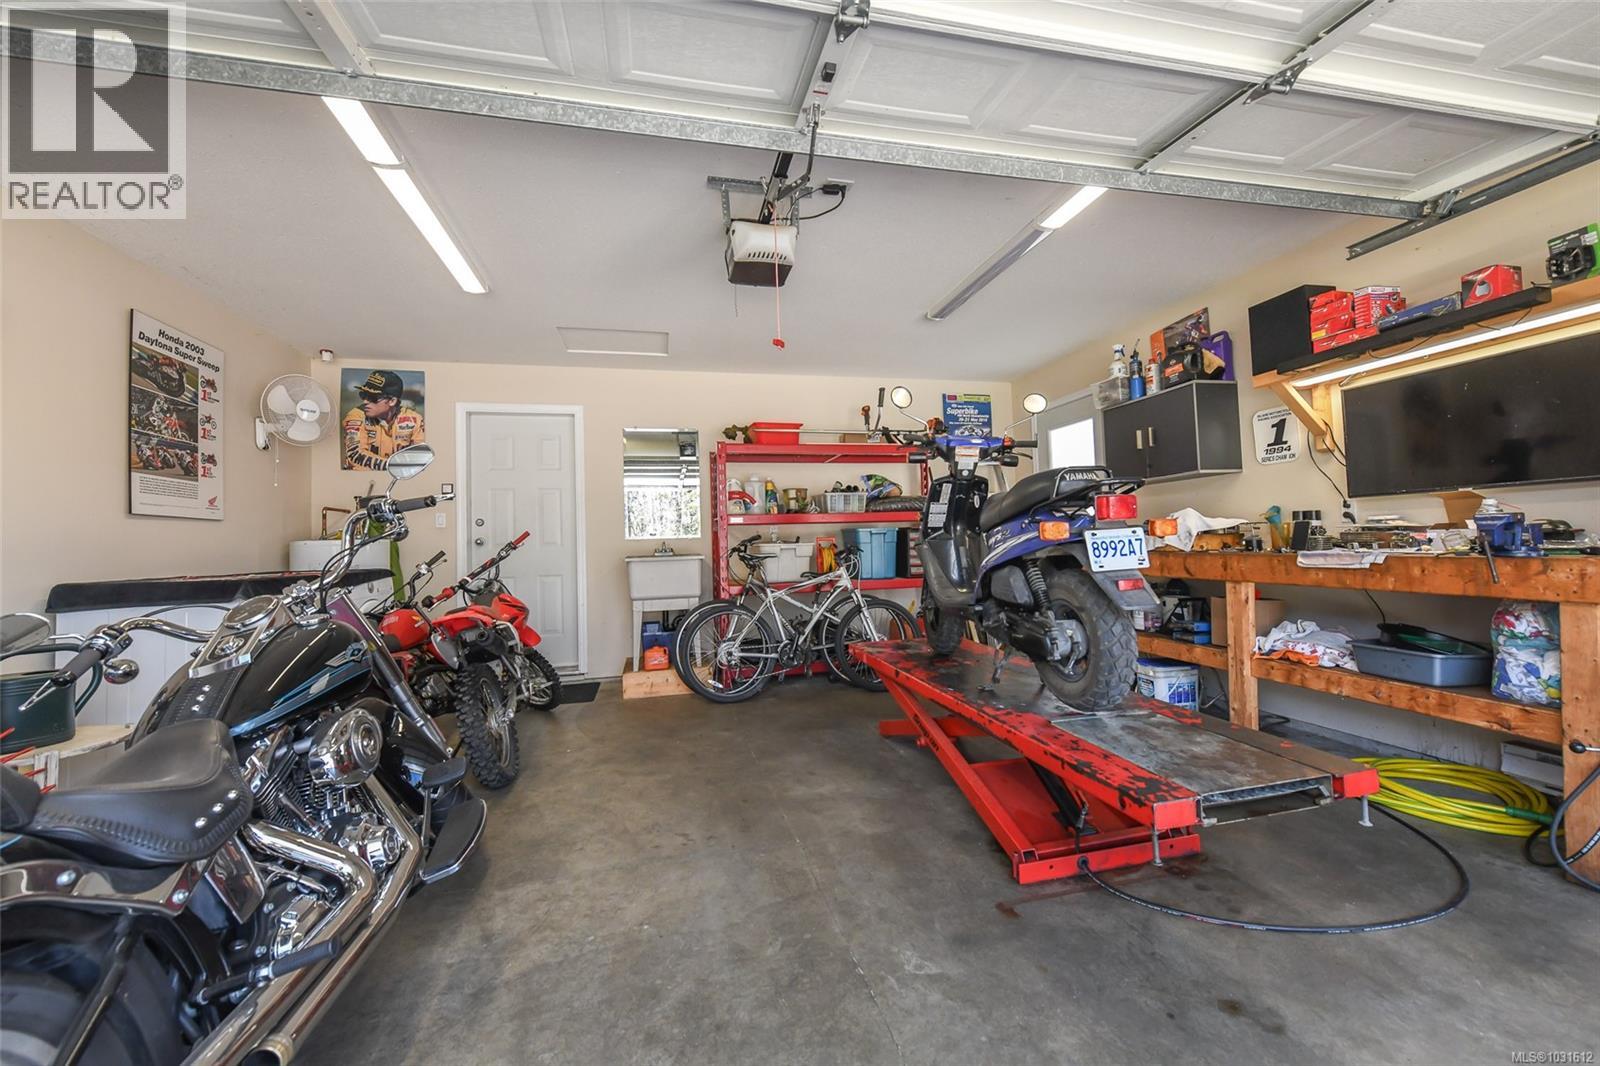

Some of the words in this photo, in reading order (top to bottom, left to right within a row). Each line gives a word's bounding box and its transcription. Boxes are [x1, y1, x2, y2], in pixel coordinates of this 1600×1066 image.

[138, 331, 173, 353] Daytona
[174, 346, 196, 362] Super
[197, 356, 220, 373] Sweep
[158, 329, 184, 347] Honda
[185, 341, 205, 356] 2003
[946, 407, 978, 416] Superbike
[1267, 417, 1288, 447] 1
[1263, 445, 1291, 455] 1994
[1091, 538, 1143, 558] 8992A7
